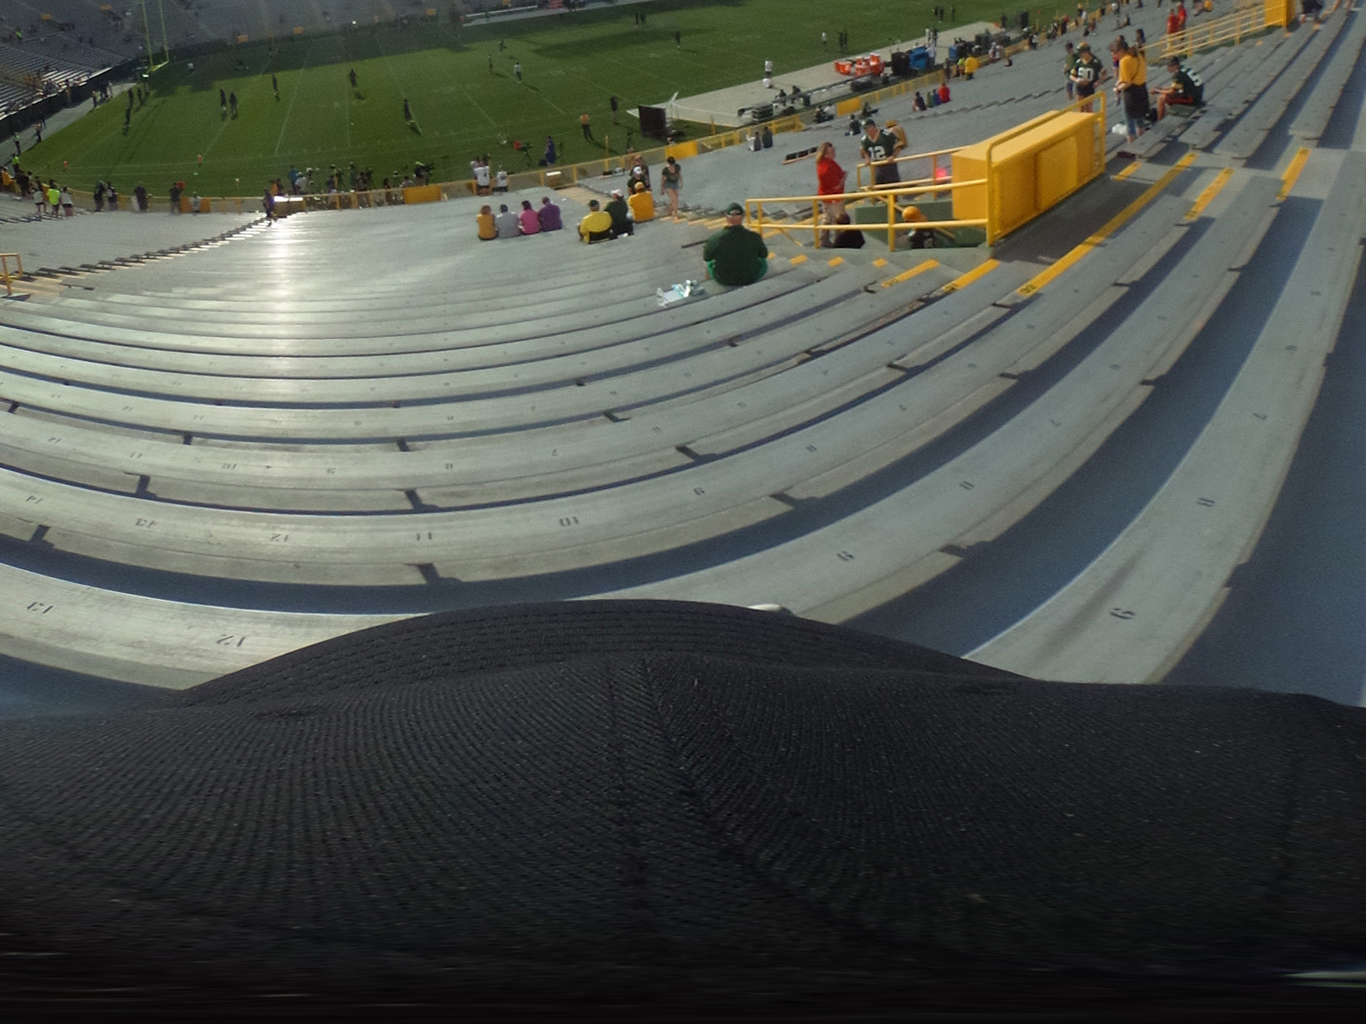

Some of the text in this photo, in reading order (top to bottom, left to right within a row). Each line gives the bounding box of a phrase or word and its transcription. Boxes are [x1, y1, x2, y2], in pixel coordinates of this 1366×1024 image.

[867, 145, 886, 161] 12
[134, 517, 156, 529] 13
[272, 533, 291, 544] 12
[416, 531, 434, 543] 11
[26, 601, 55, 615] 13
[216, 633, 247, 648] 12
